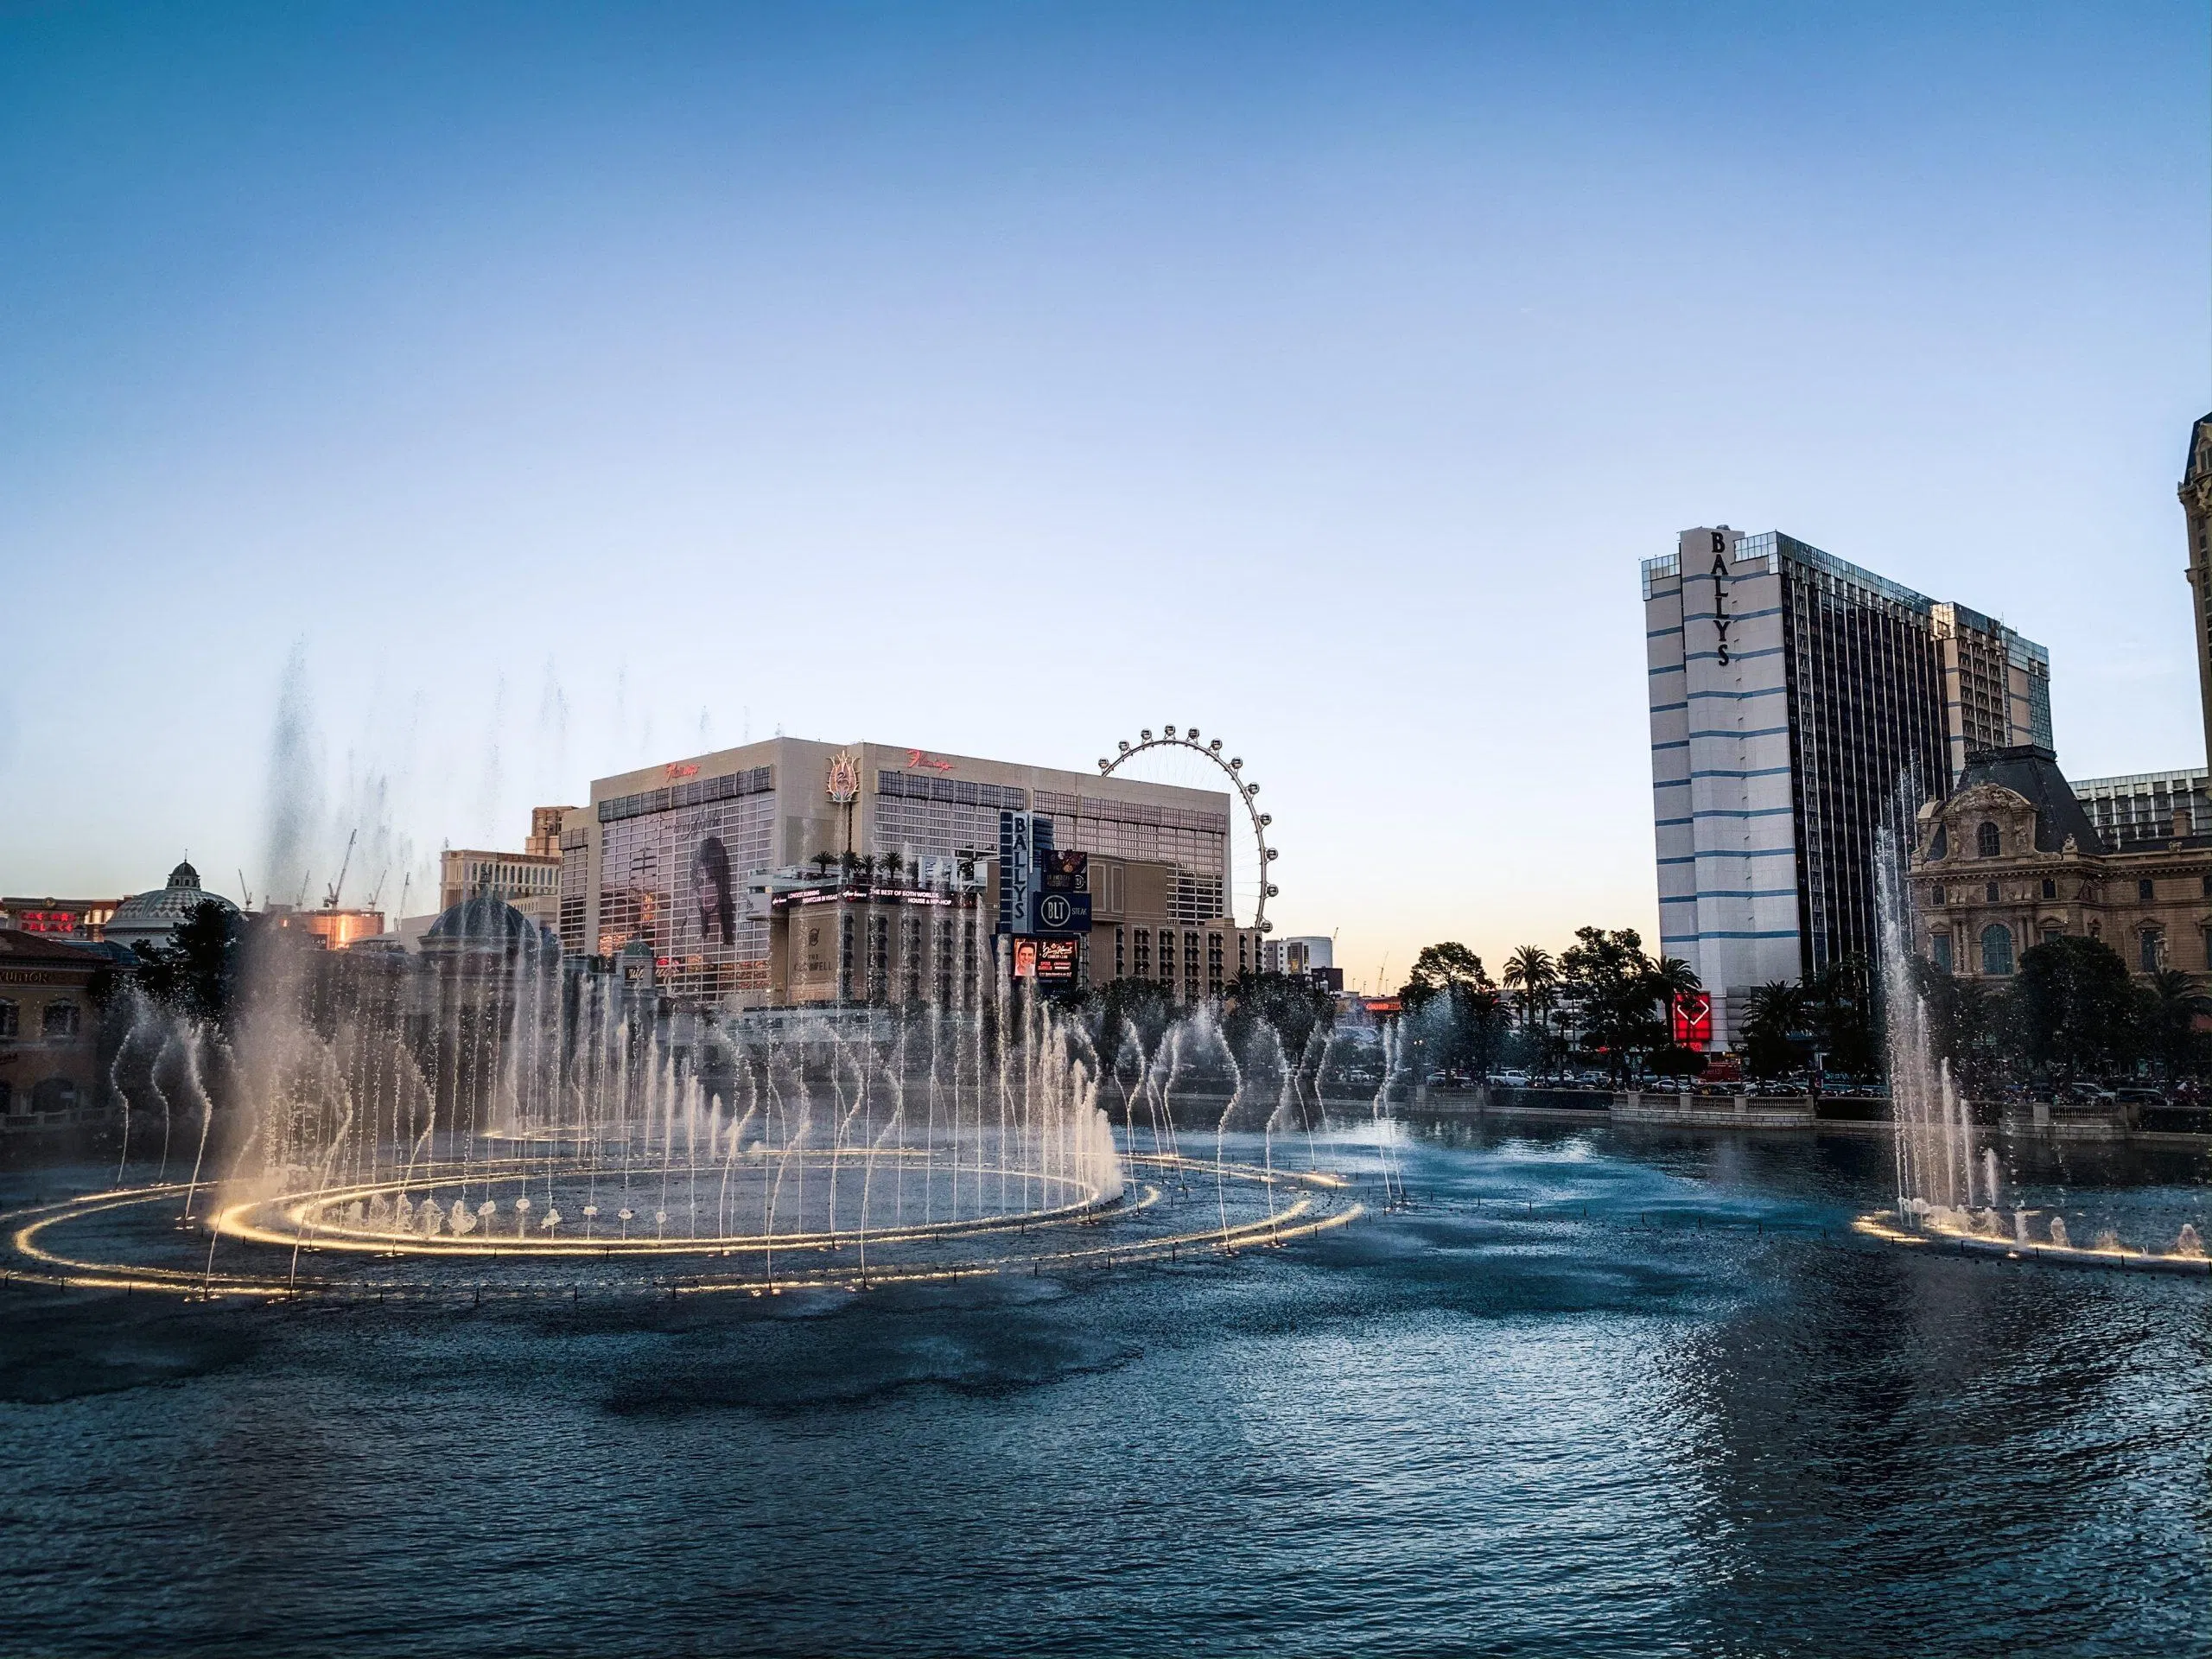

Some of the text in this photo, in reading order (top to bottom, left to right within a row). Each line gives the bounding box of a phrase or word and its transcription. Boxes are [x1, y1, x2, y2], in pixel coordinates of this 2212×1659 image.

[1711, 531, 1731, 667] BALLYS
[1013, 817, 1027, 919] BALLYS
[1048, 901, 1087, 919] BLT STEAK
